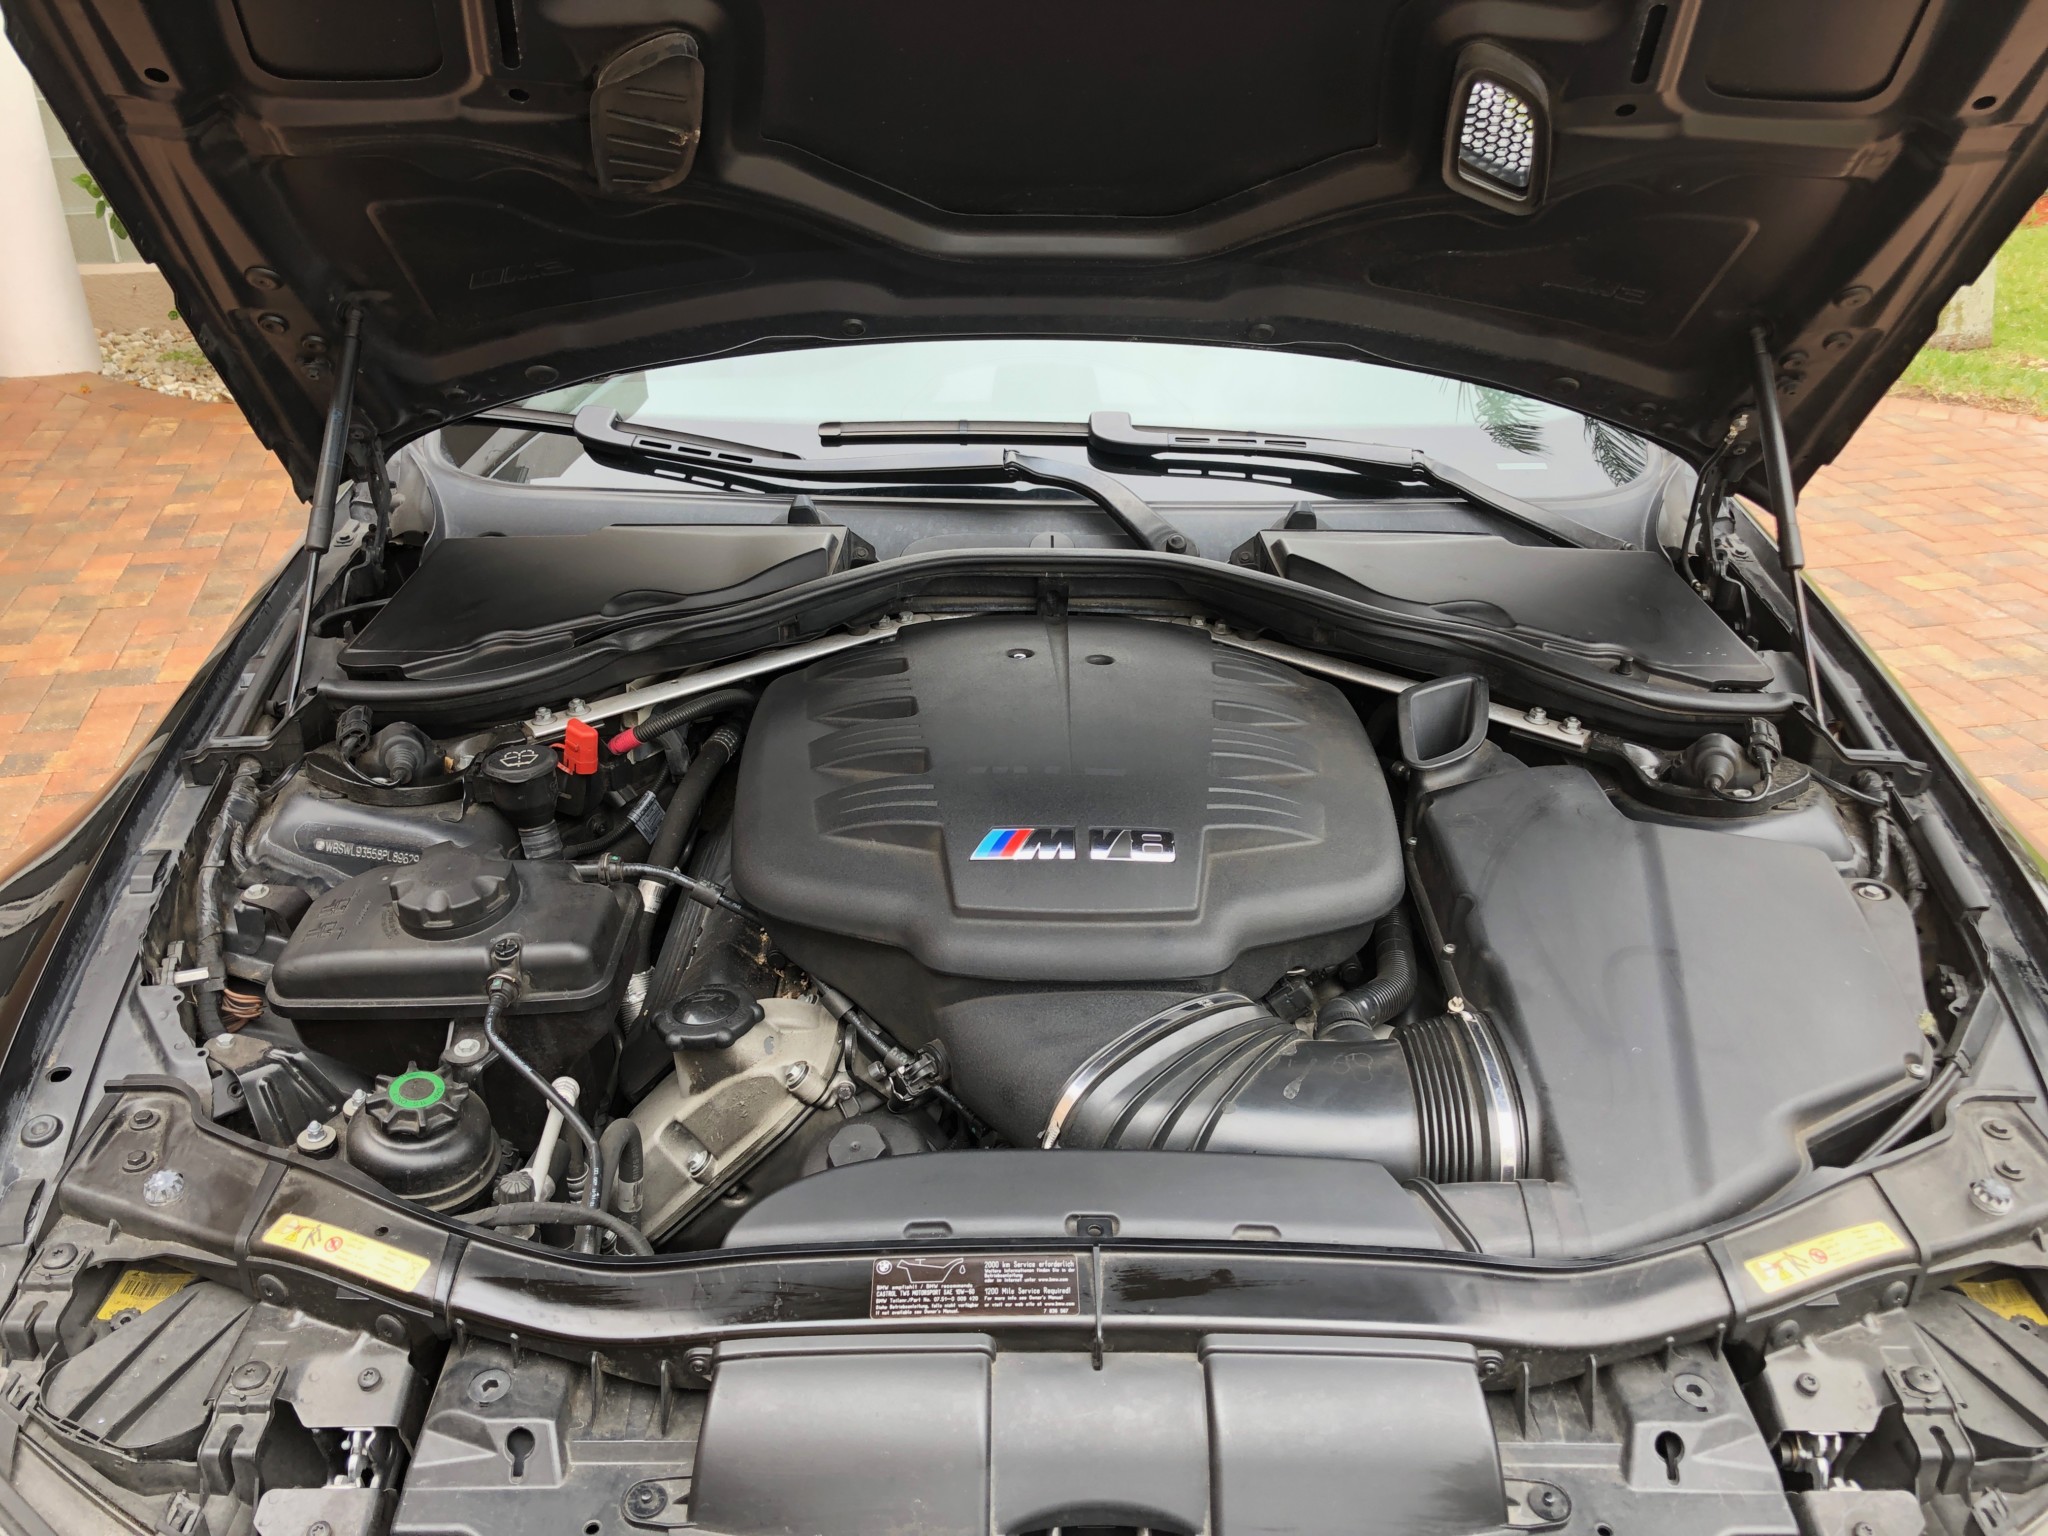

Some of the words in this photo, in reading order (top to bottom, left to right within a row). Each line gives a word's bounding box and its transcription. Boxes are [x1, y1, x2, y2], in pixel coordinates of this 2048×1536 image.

[1089, 827, 1176, 862] V8
[1039, 1260, 1074, 1268] erforderlich
[1044, 1287, 1071, 1295] Required!
